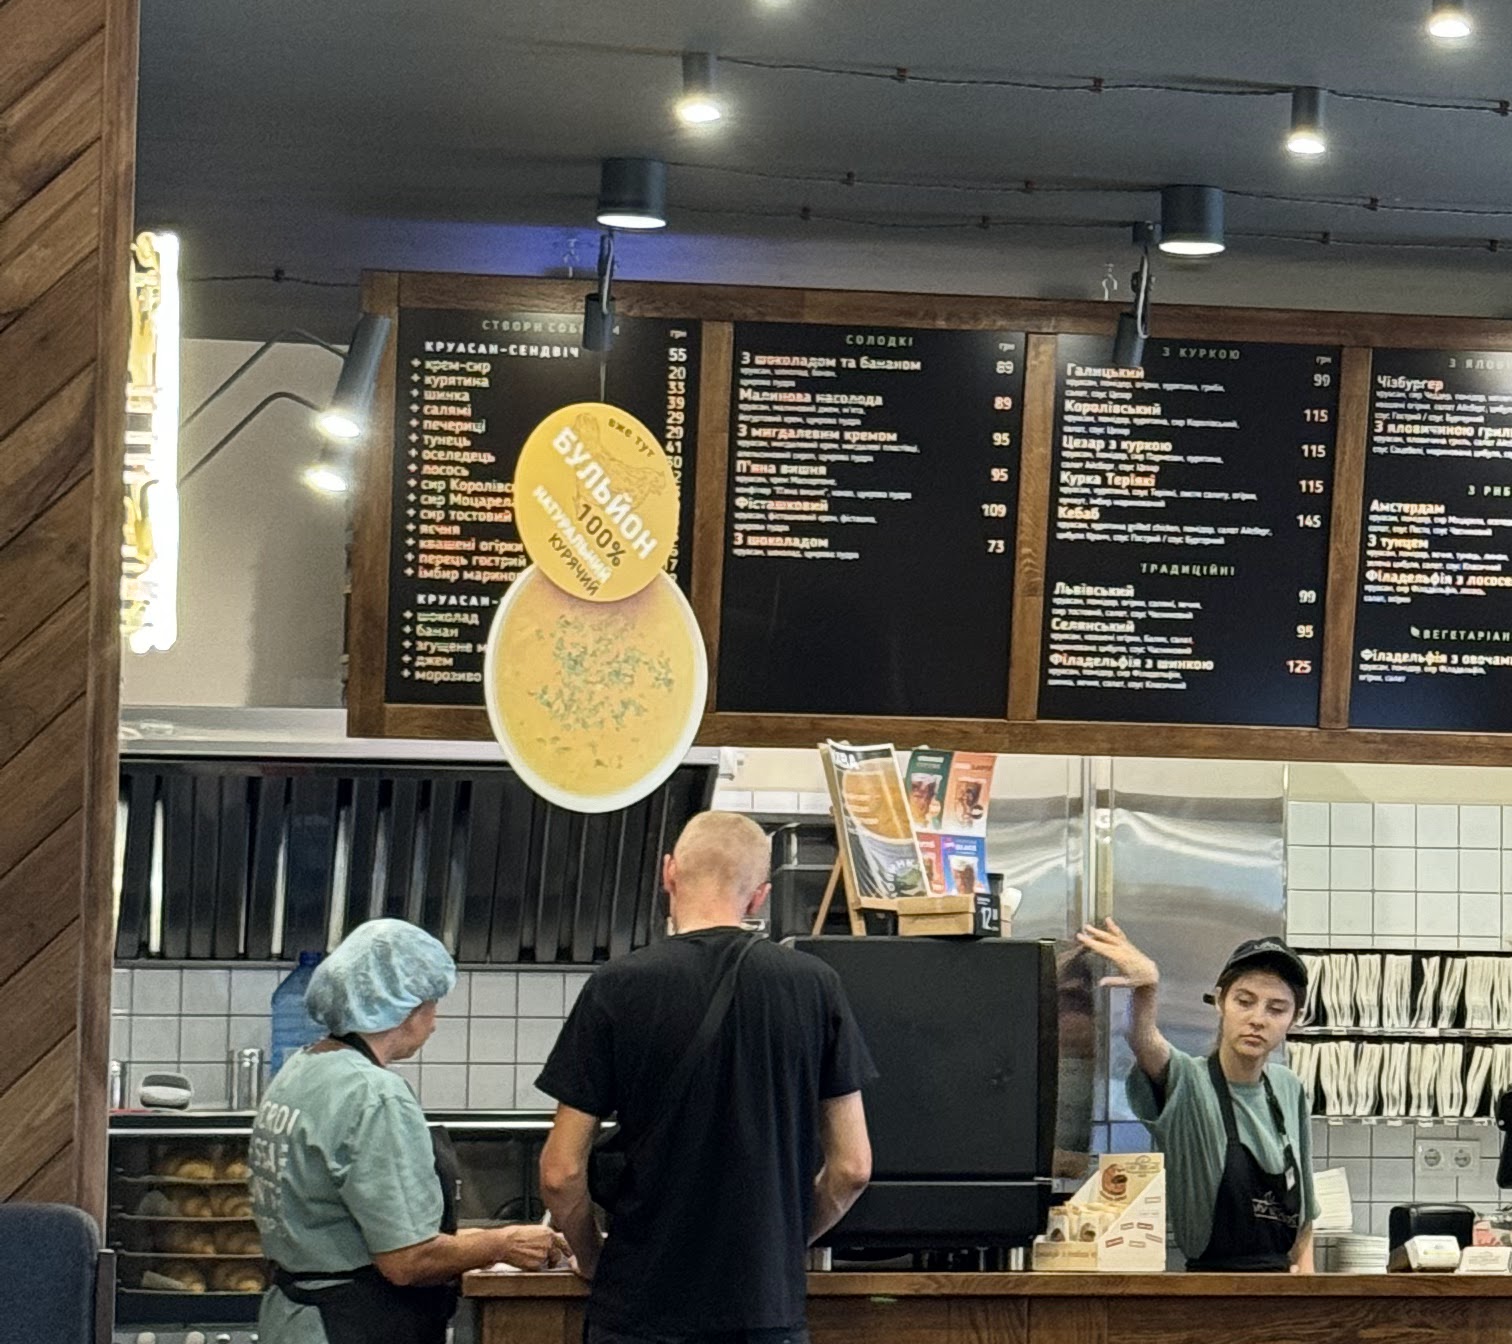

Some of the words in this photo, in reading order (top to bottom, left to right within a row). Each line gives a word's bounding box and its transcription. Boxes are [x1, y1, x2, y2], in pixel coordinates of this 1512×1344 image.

[482, 320, 542, 333] СТВОРИ
[846, 335, 914, 347] СОЛОДКІ
[424, 341, 579, 359] КРУАСАН-СЕНДВІЧ
[668, 348, 687, 362] 55
[1179, 348, 1241, 360] КУРКОЮ
[741, 351, 751, 365] З
[754, 355, 837, 369] шоколадом
[840, 358, 857, 369] та
[860, 356, 921, 371] бананом
[996, 360, 1014, 374] 89
[668, 366, 686, 380] 20
[1066, 363, 1145, 379] Галицький
[1313, 374, 1331, 387] 99
[424, 375, 490, 388] курятина
[667, 380, 685, 394] 33
[1377, 375, 1444, 393] Чізбургер
[667, 396, 685, 410] 39
[739, 387, 812, 403] Малинова
[815, 393, 883, 407] насолода
[994, 397, 1013, 410] 89
[423, 404, 471, 417] салямі
[666, 411, 685, 424] 29
[1064, 399, 1162, 416] Королівський
[1303, 409, 1329, 422] 115
[423, 419, 486, 434] печериці
[737, 424, 748, 437] З
[843, 431, 898, 443] кремом
[992, 432, 1010, 446] 95
[1374, 420, 1384, 433] З
[1387, 423, 1475, 437] яловичиною
[423, 434, 471, 448] тунець
[666, 440, 682, 454] 41
[635, 435, 656, 458] тут
[1062, 435, 1105, 450] Цезар
[1120, 440, 1173, 453] куркою
[1301, 444, 1326, 458] 115
[422, 449, 496, 463] оселедець
[421, 464, 469, 476] лосось
[991, 468, 1009, 482] 95
[421, 479, 446, 493] сир
[1060, 471, 1101, 486] Курка
[1105, 472, 1156, 488] Теріякі
[1299, 479, 1324, 493] 115
[553, 426, 658, 559] БУЛЬЙОН
[420, 509, 445, 522] сир
[448, 509, 512, 523] тостовий
[735, 496, 829, 512] Фісташковий
[981, 504, 1007, 517] 109
[1370, 499, 1446, 515] Амстердам
[1057, 507, 1100, 520] Кебаб
[1296, 514, 1322, 528] 145
[532, 485, 612, 584] НАТУРАЛЬНИЙ
[577, 504, 627, 567] 100%
[733, 532, 743, 545] З
[747, 535, 829, 549] шоколадом
[987, 539, 1005, 553] 73
[1367, 534, 1377, 548] З
[1380, 538, 1429, 551] тунцем
[472, 555, 527, 569] гострий
[548, 532, 601, 596] КУРЯЧИЙ
[1140, 562, 1235, 577] ТРАДИЦІЙНІ
[1365, 569, 1453, 586] Філадельфія
[1054, 581, 1135, 597] Львівський
[1299, 590, 1317, 604] 99
[1051, 617, 1135, 633] Селянський
[1296, 625, 1314, 639] 95
[1049, 653, 1142, 669] Філадельфія
[1156, 659, 1214, 671] шинкою
[1286, 660, 1312, 674] 125
[1360, 648, 1448, 665] Філадельфія
